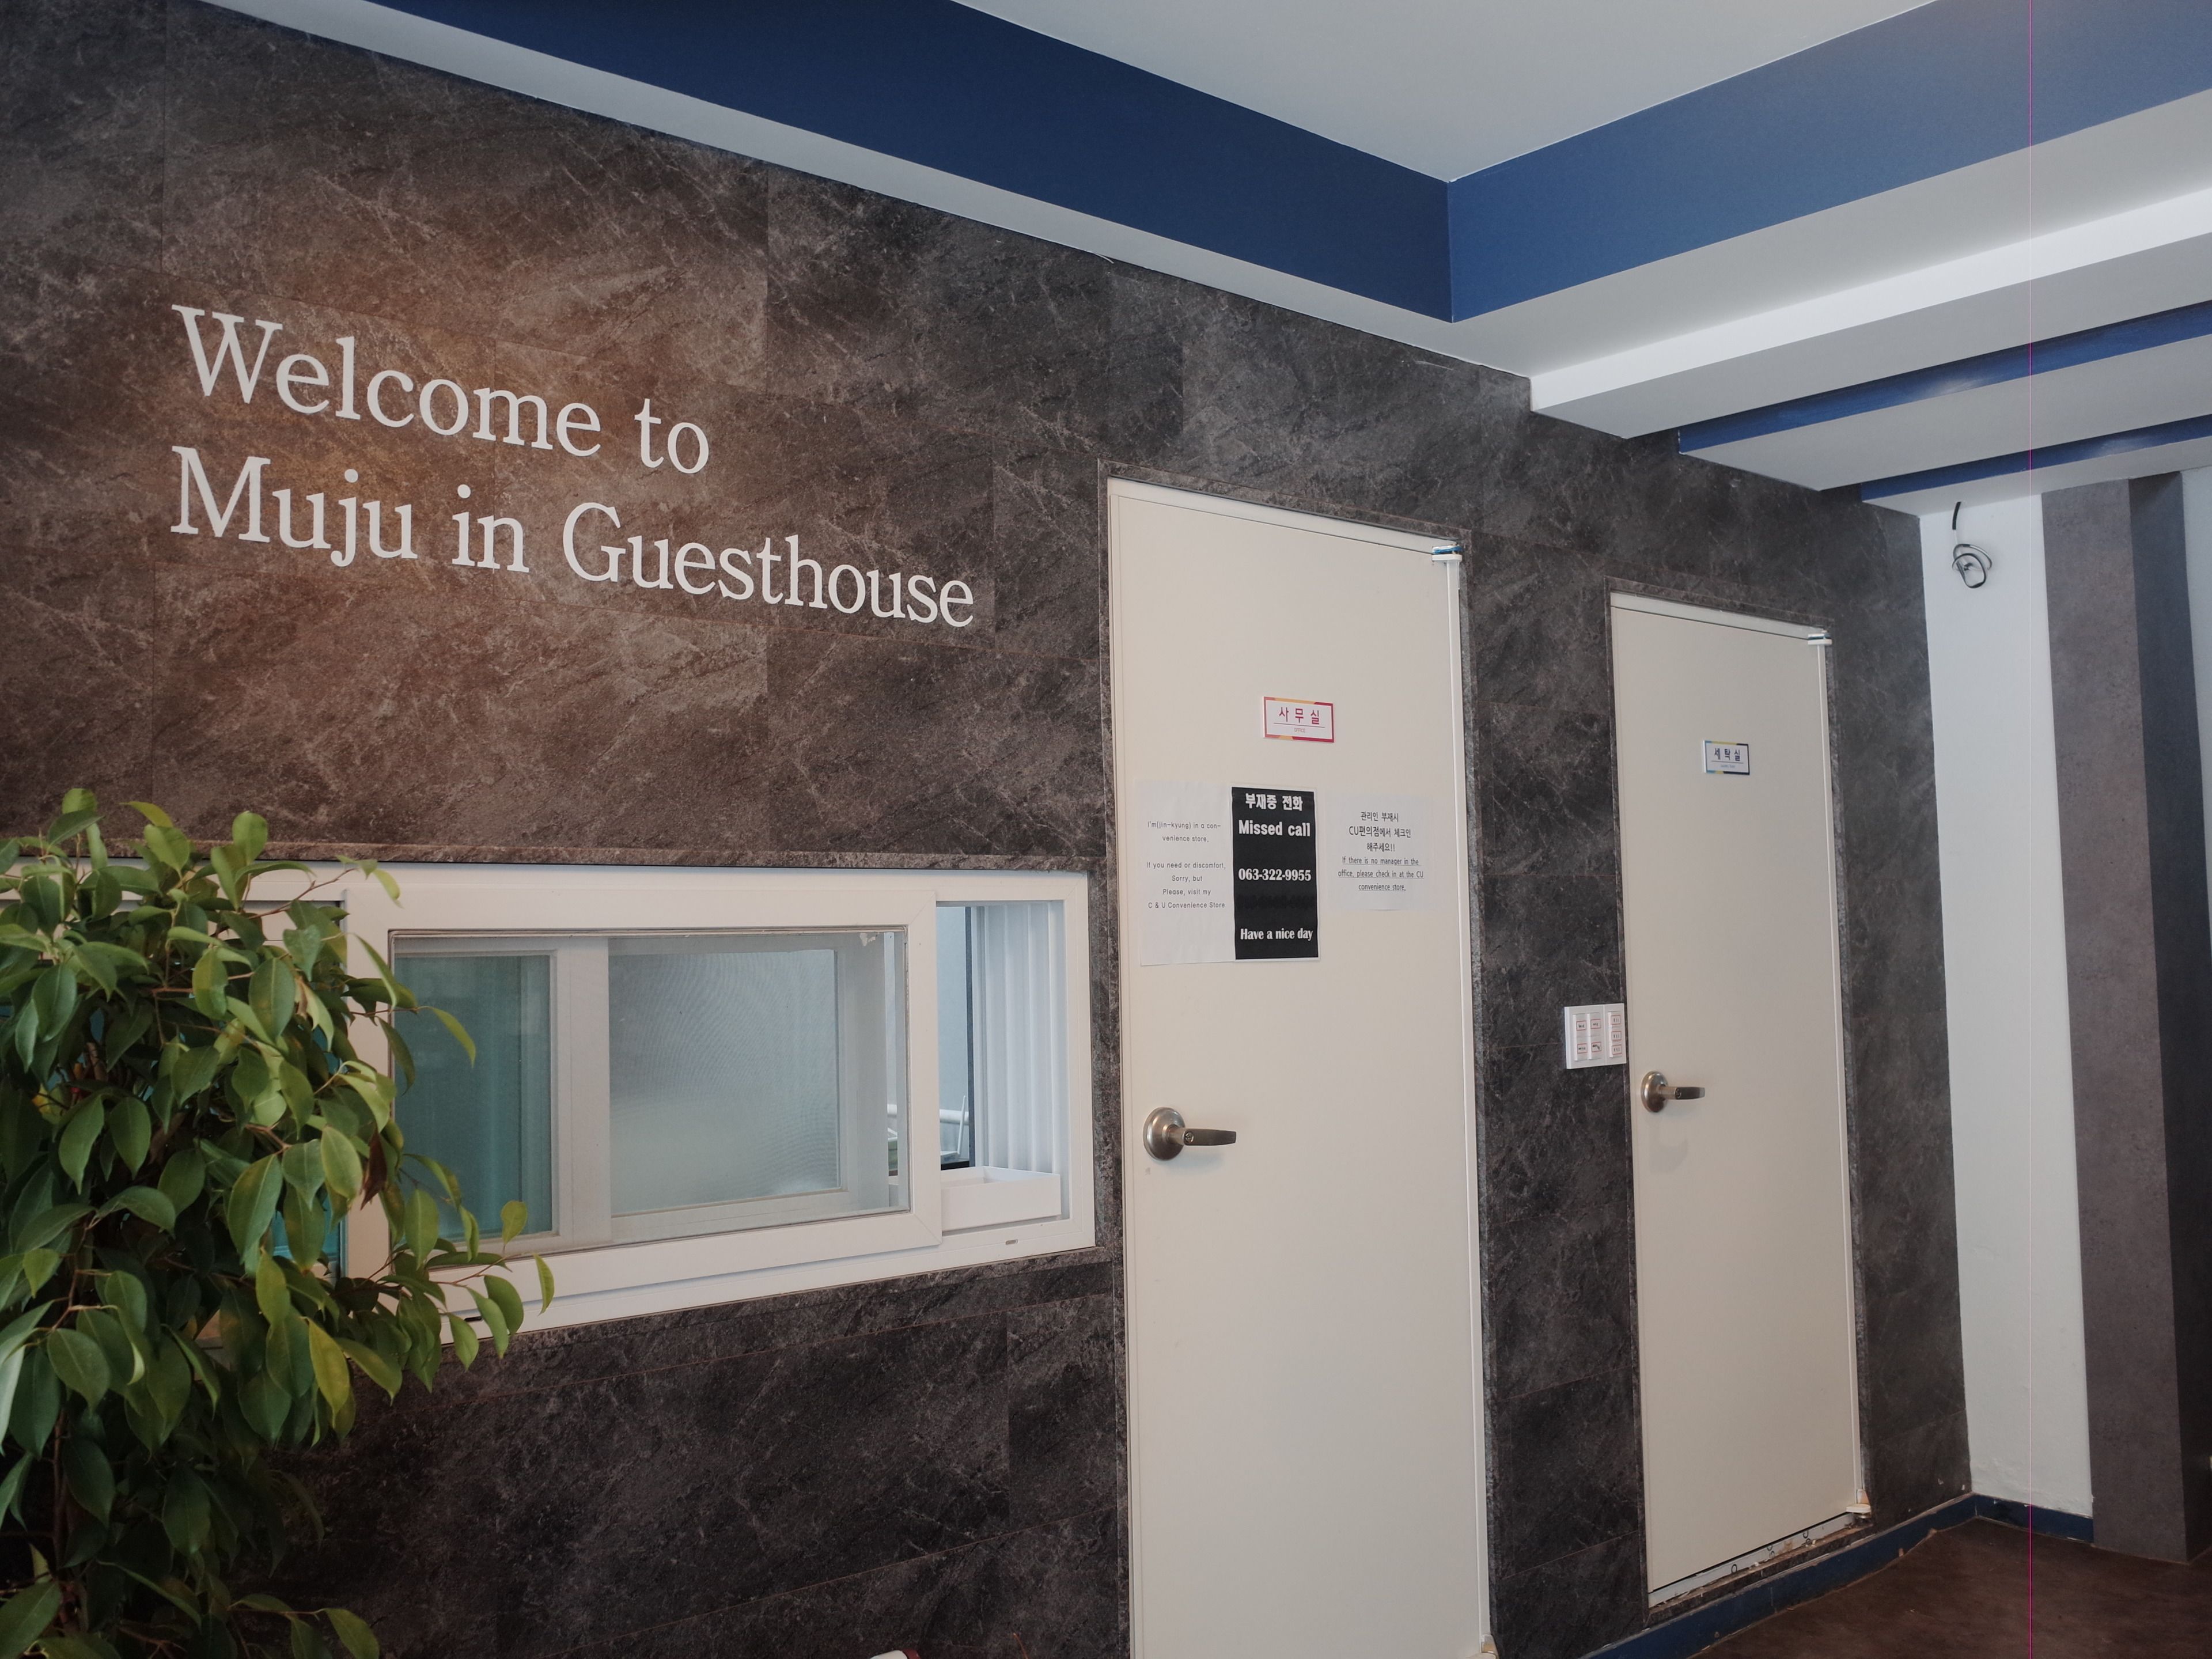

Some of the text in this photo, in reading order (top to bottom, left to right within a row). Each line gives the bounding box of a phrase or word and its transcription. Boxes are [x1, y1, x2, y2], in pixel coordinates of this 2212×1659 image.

[171, 303, 710, 475] Welcome to
[170, 445, 975, 628] Muju in Guesthouse
[1279, 706, 1320, 725] 사무실
[1714, 747, 1740, 762] 세탁실
[1245, 793, 1303, 812] 부재중 전화
[1360, 811, 1399, 823] 관리인 부재시
[1238, 820, 1310, 836] Missed call
[1349, 826, 1411, 838] CU편의점에서 체크인
[1366, 842, 1395, 852] 해주세요!!
[1192, 862, 1226, 870] discomfort,
[1342, 856, 1346, 864] If
[1380, 858, 1402, 866] manager
[1172, 875, 1191, 883] Sorry,
[1238, 868, 1312, 881] 063-322-9955
[1357, 870, 1373, 878] please
[1240, 928, 1313, 941] Have a nice day
